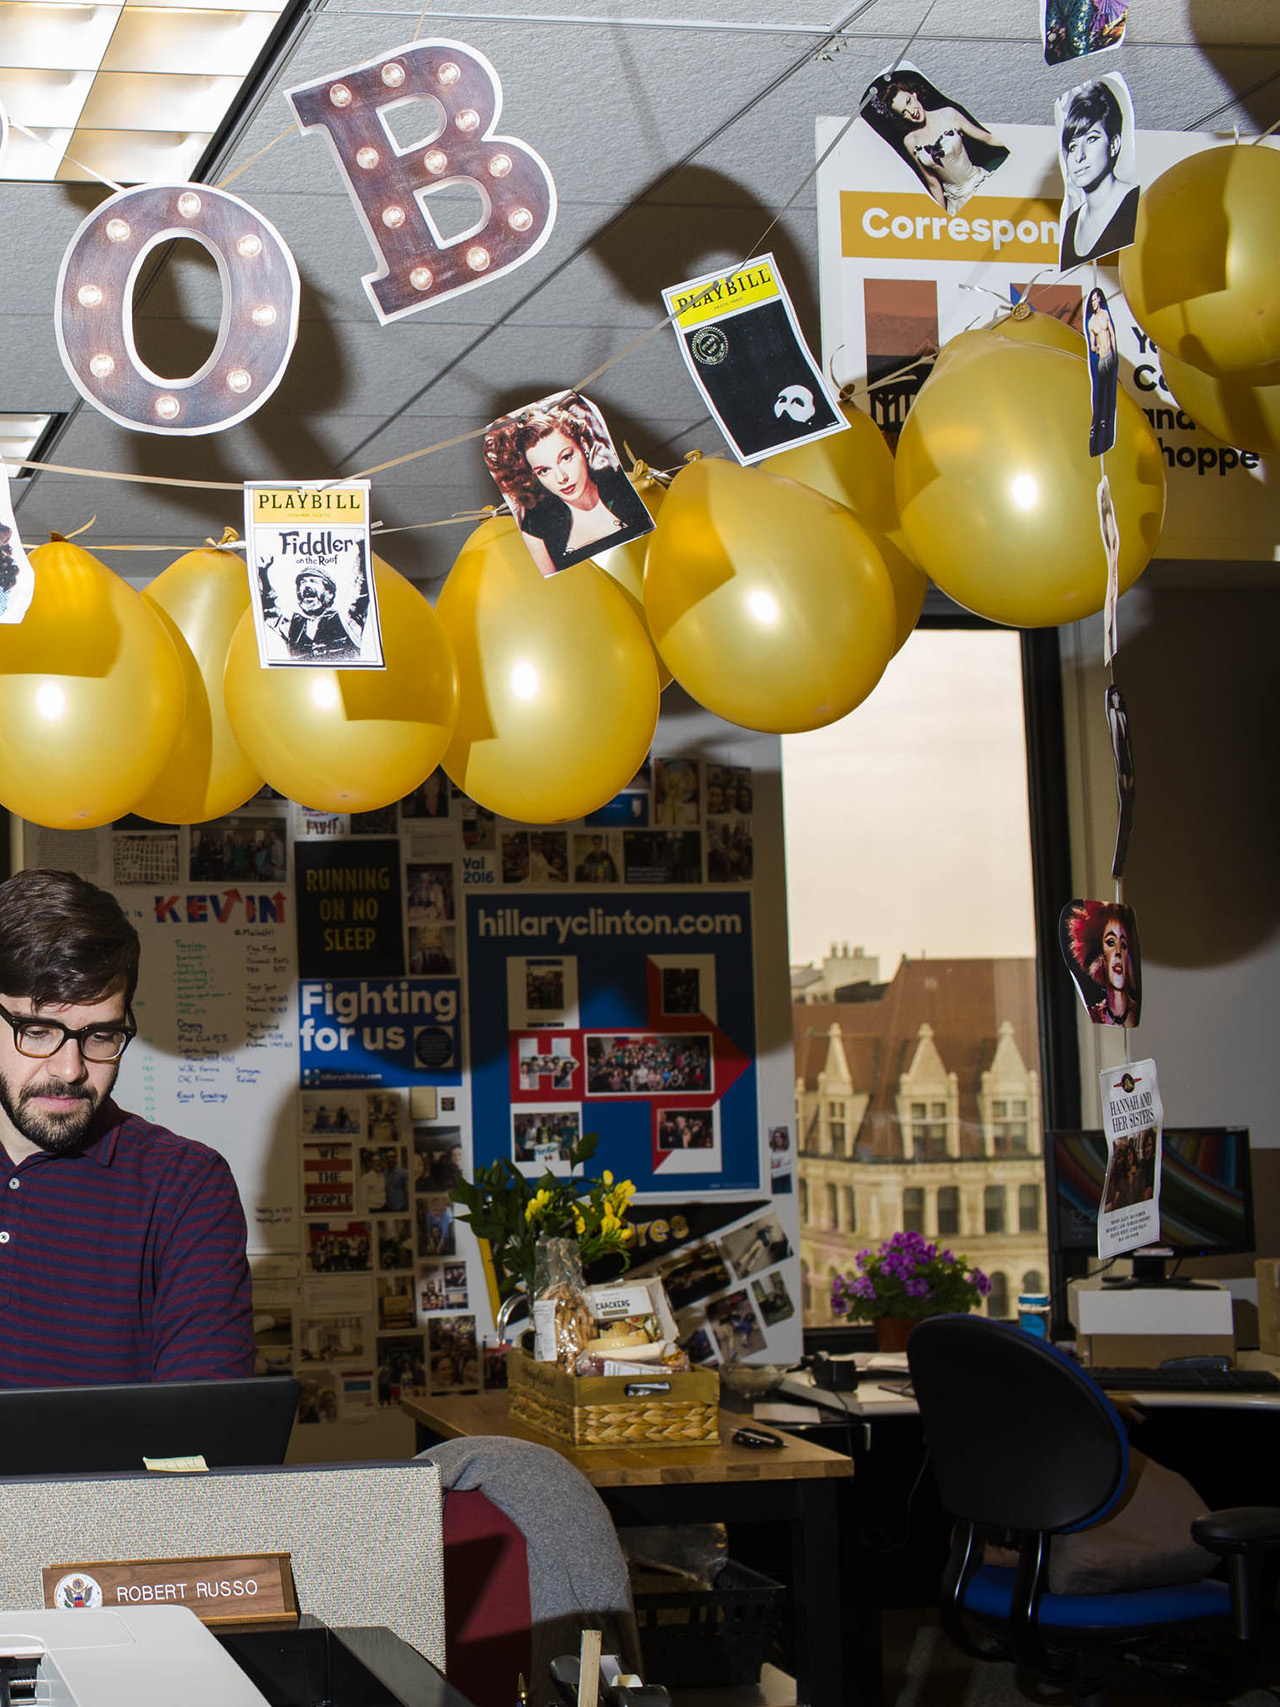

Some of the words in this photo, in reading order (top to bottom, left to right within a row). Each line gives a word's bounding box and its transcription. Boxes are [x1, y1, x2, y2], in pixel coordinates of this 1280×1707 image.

[677, 268, 771, 314] PLAYBILL
[259, 494, 361, 509] PLAYBILL
[279, 531, 354, 556] Fiddler
[318, 555, 339, 567] Roof
[462, 857, 485, 869] Val
[306, 867, 390, 892] RUNNING
[462, 871, 495, 884] 2016
[154, 888, 287, 924] KEVIN
[320, 897, 345, 921] ON
[352, 897, 379, 921] NO
[477, 908, 742, 944] hillaryclinton.com
[323, 927, 377, 952] SLEEP
[302, 982, 457, 1024] Fighting
[300, 1018, 355, 1052] for
[363, 1026, 407, 1051] us
[1110, 1094, 1140, 1116] HANNAH
[1140, 1091, 1153, 1109] AND
[1112, 1114, 1129, 1133] HER
[1129, 1108, 1156, 1127] SISTERS
[318, 1146, 339, 1160] WE
[318, 1171, 342, 1184] THE
[306, 1194, 353, 1206] PEOPLE
[596, 1299, 631, 1310] CRACKERS
[117, 1583, 187, 1602] ROBERT
[196, 1579, 259, 1599] RUSSO
